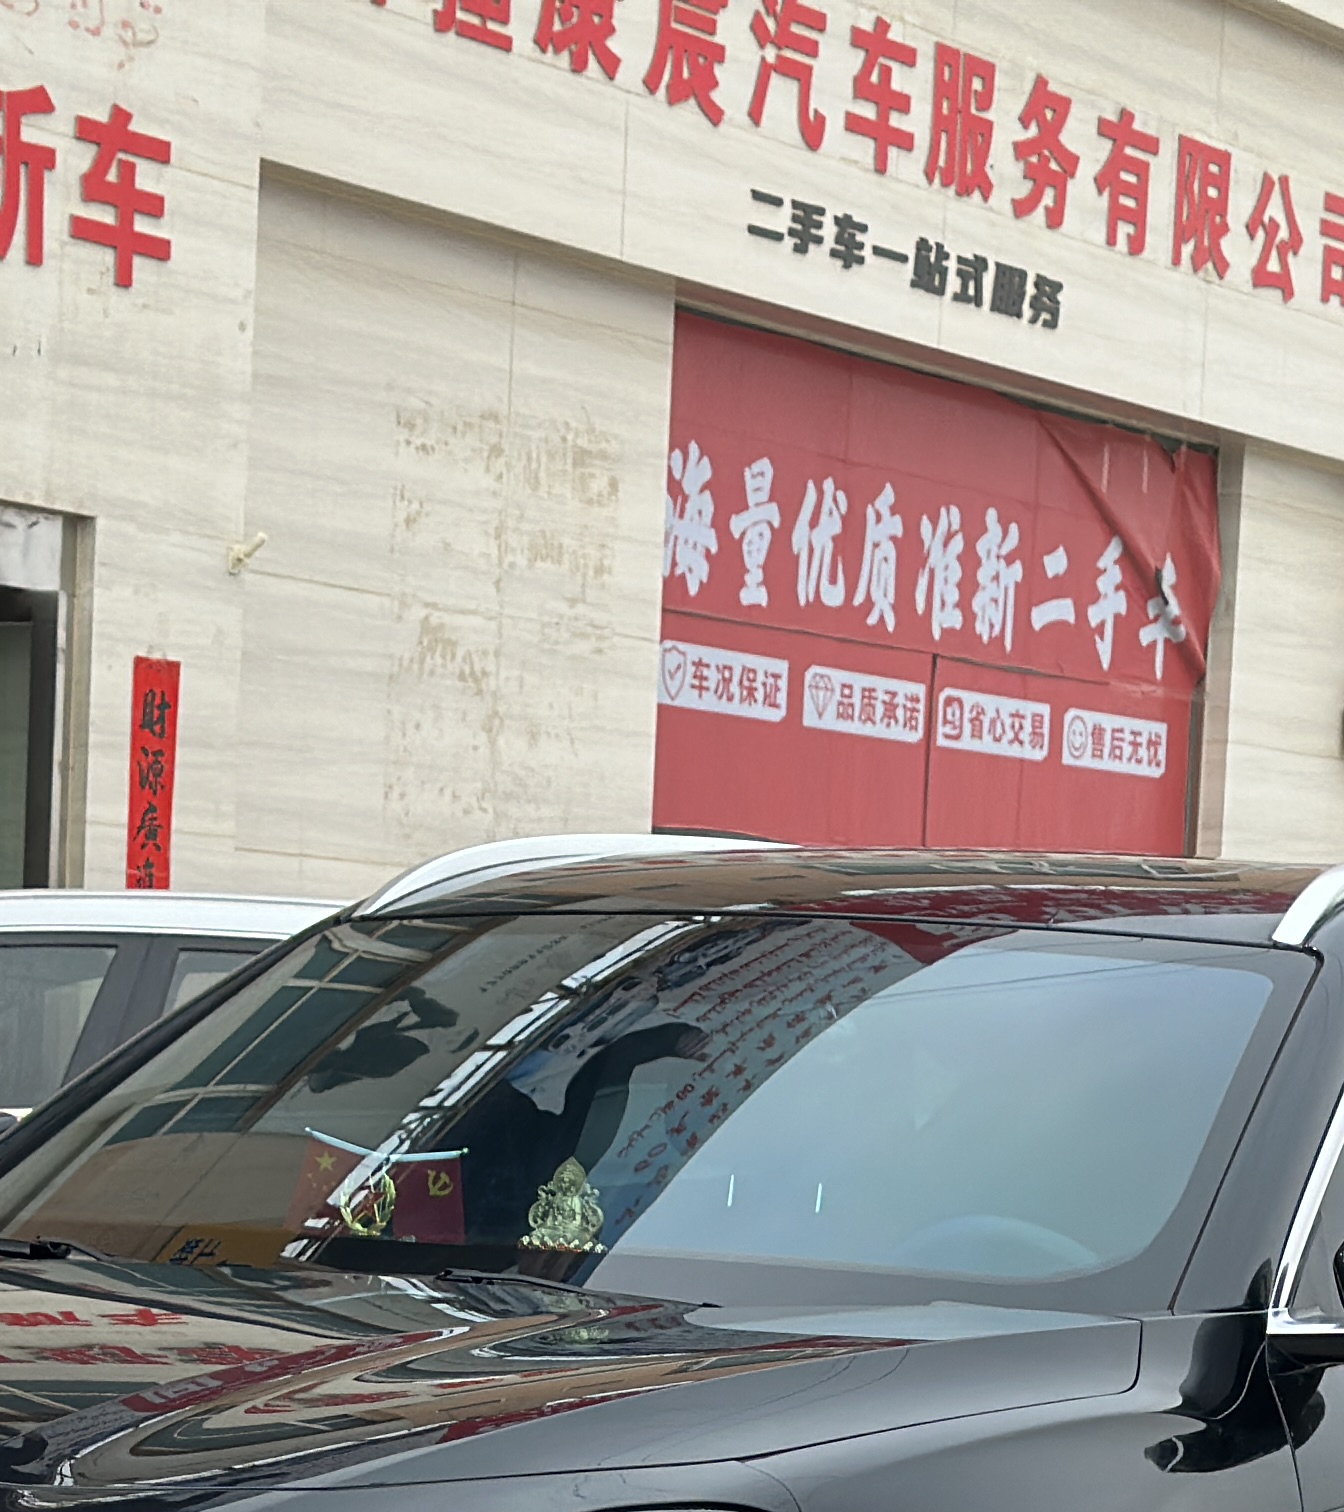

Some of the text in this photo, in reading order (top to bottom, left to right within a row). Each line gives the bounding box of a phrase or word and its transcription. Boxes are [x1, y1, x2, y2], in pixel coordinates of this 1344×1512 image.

[747, 188, 1064, 329] 二手车一站式服务
[689, 656, 783, 712] 车况保证
[835, 681, 923, 734] 品质承诺
[967, 700, 1047, 752] 省心交易
[1089, 724, 1164, 769] 售后无忧
